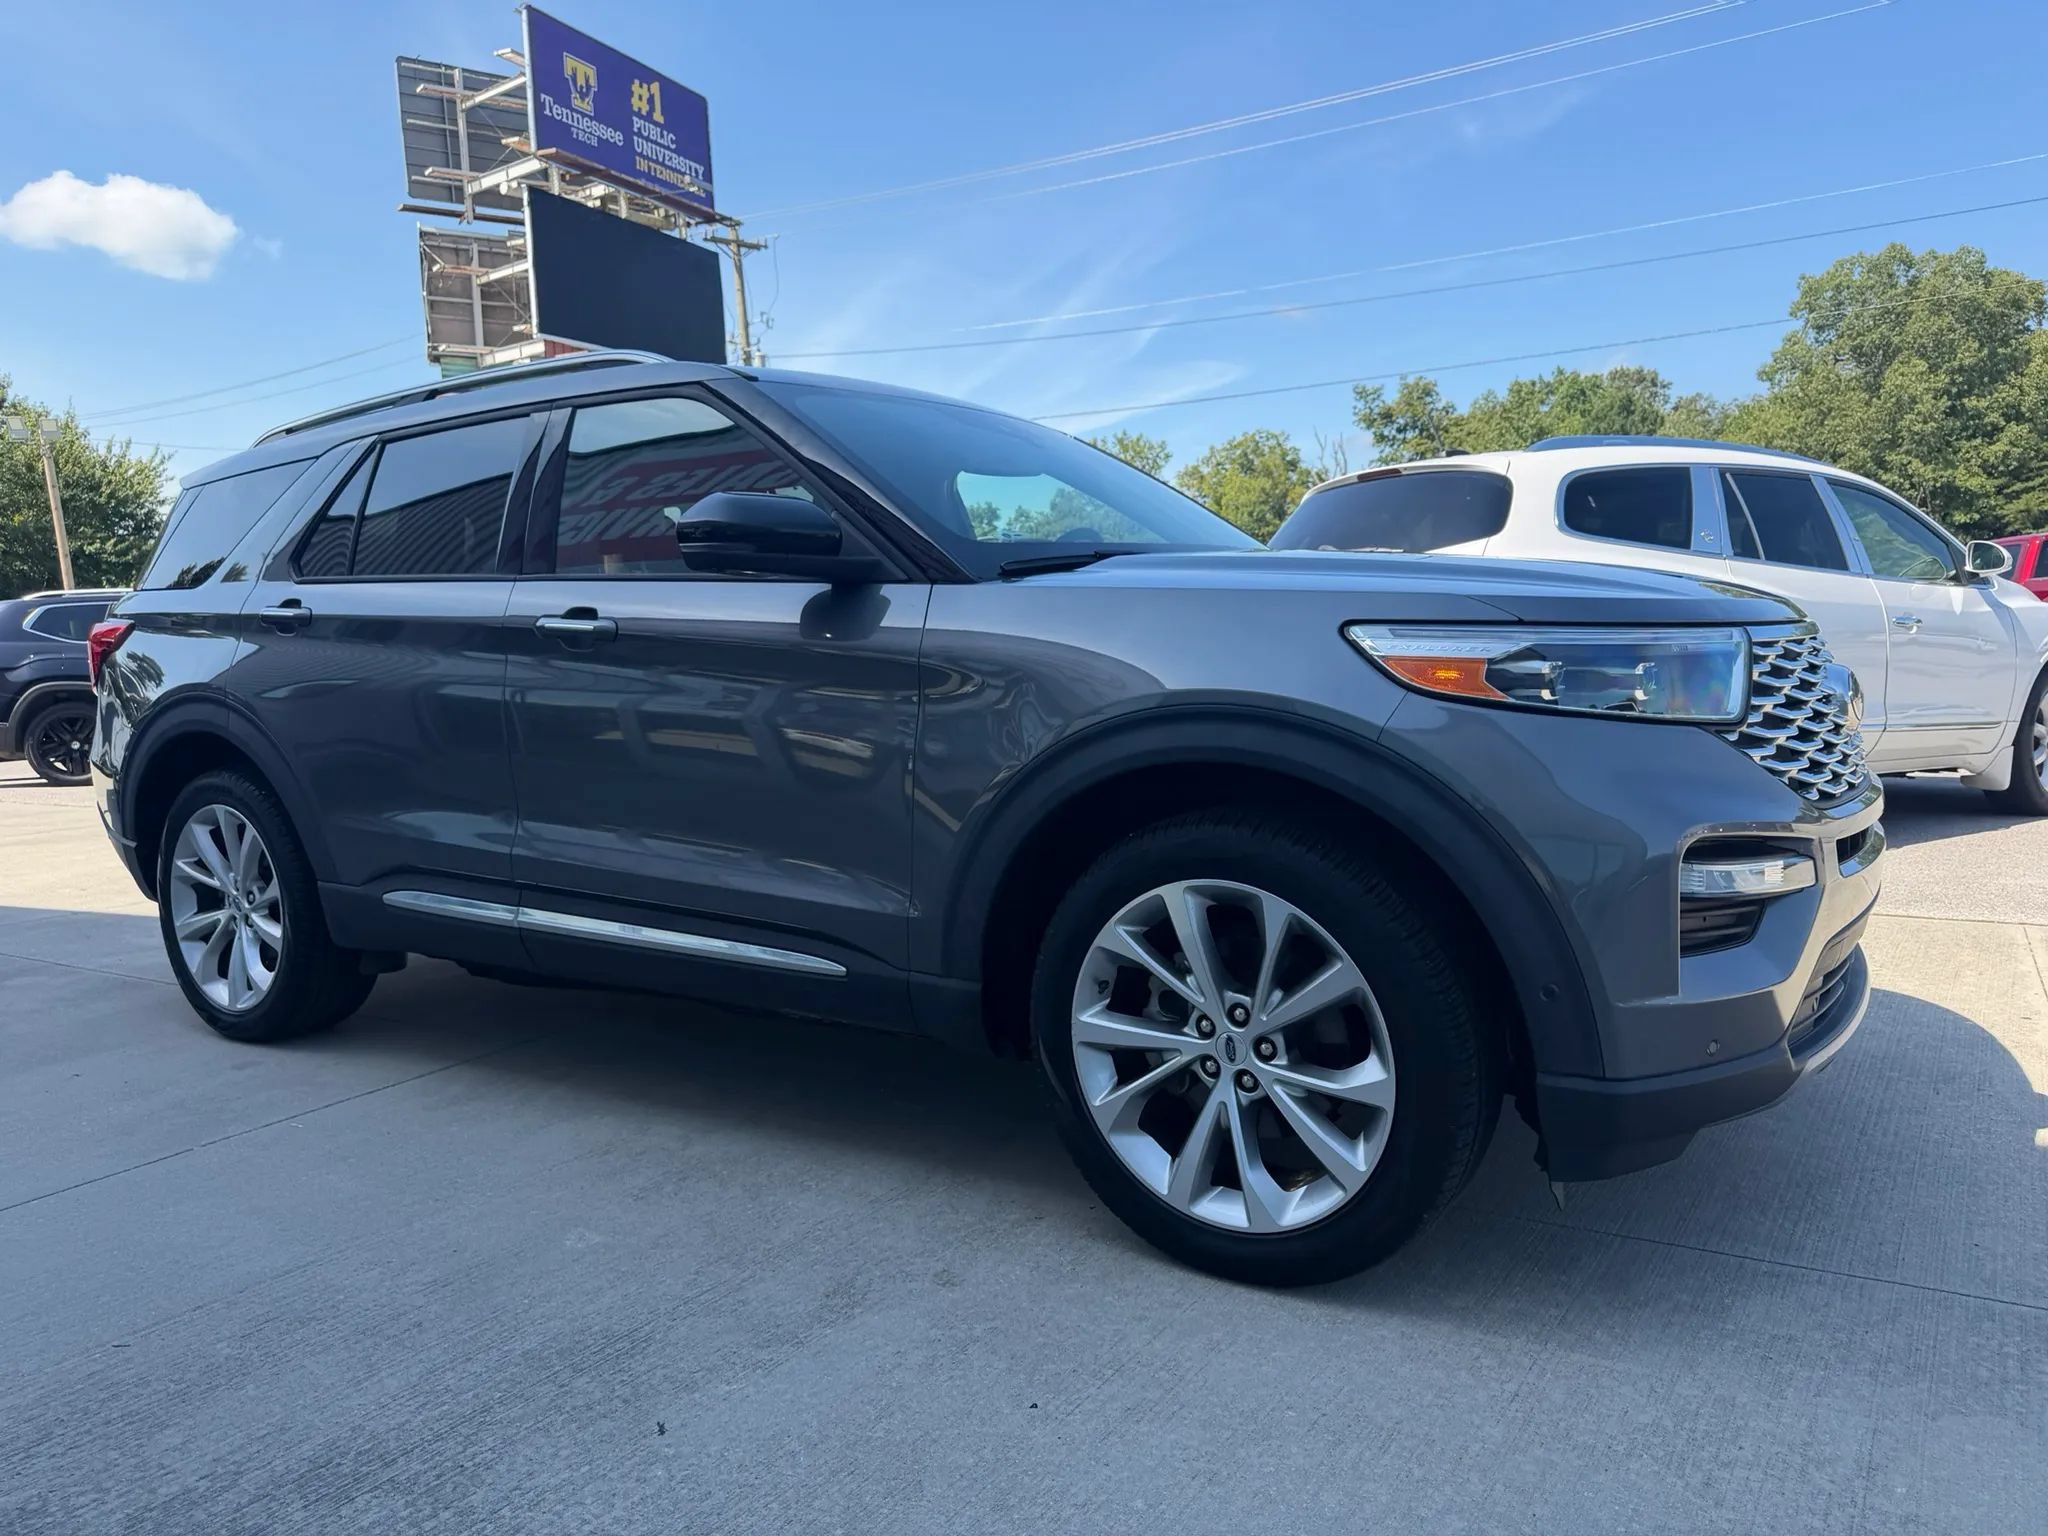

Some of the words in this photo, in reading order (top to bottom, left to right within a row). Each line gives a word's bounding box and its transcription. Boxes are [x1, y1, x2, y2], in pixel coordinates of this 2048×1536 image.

[540, 92, 624, 147] Tennessee
[631, 79, 665, 124] #1
[571, 127, 598, 147] TECH
[632, 116, 677, 149] PUBLIC
[633, 136, 705, 180] UNIVERSITY
[635, 156, 648, 173] IN
[649, 161, 706, 198] TENNE
[1387, 643, 1492, 653] EXPLORER
